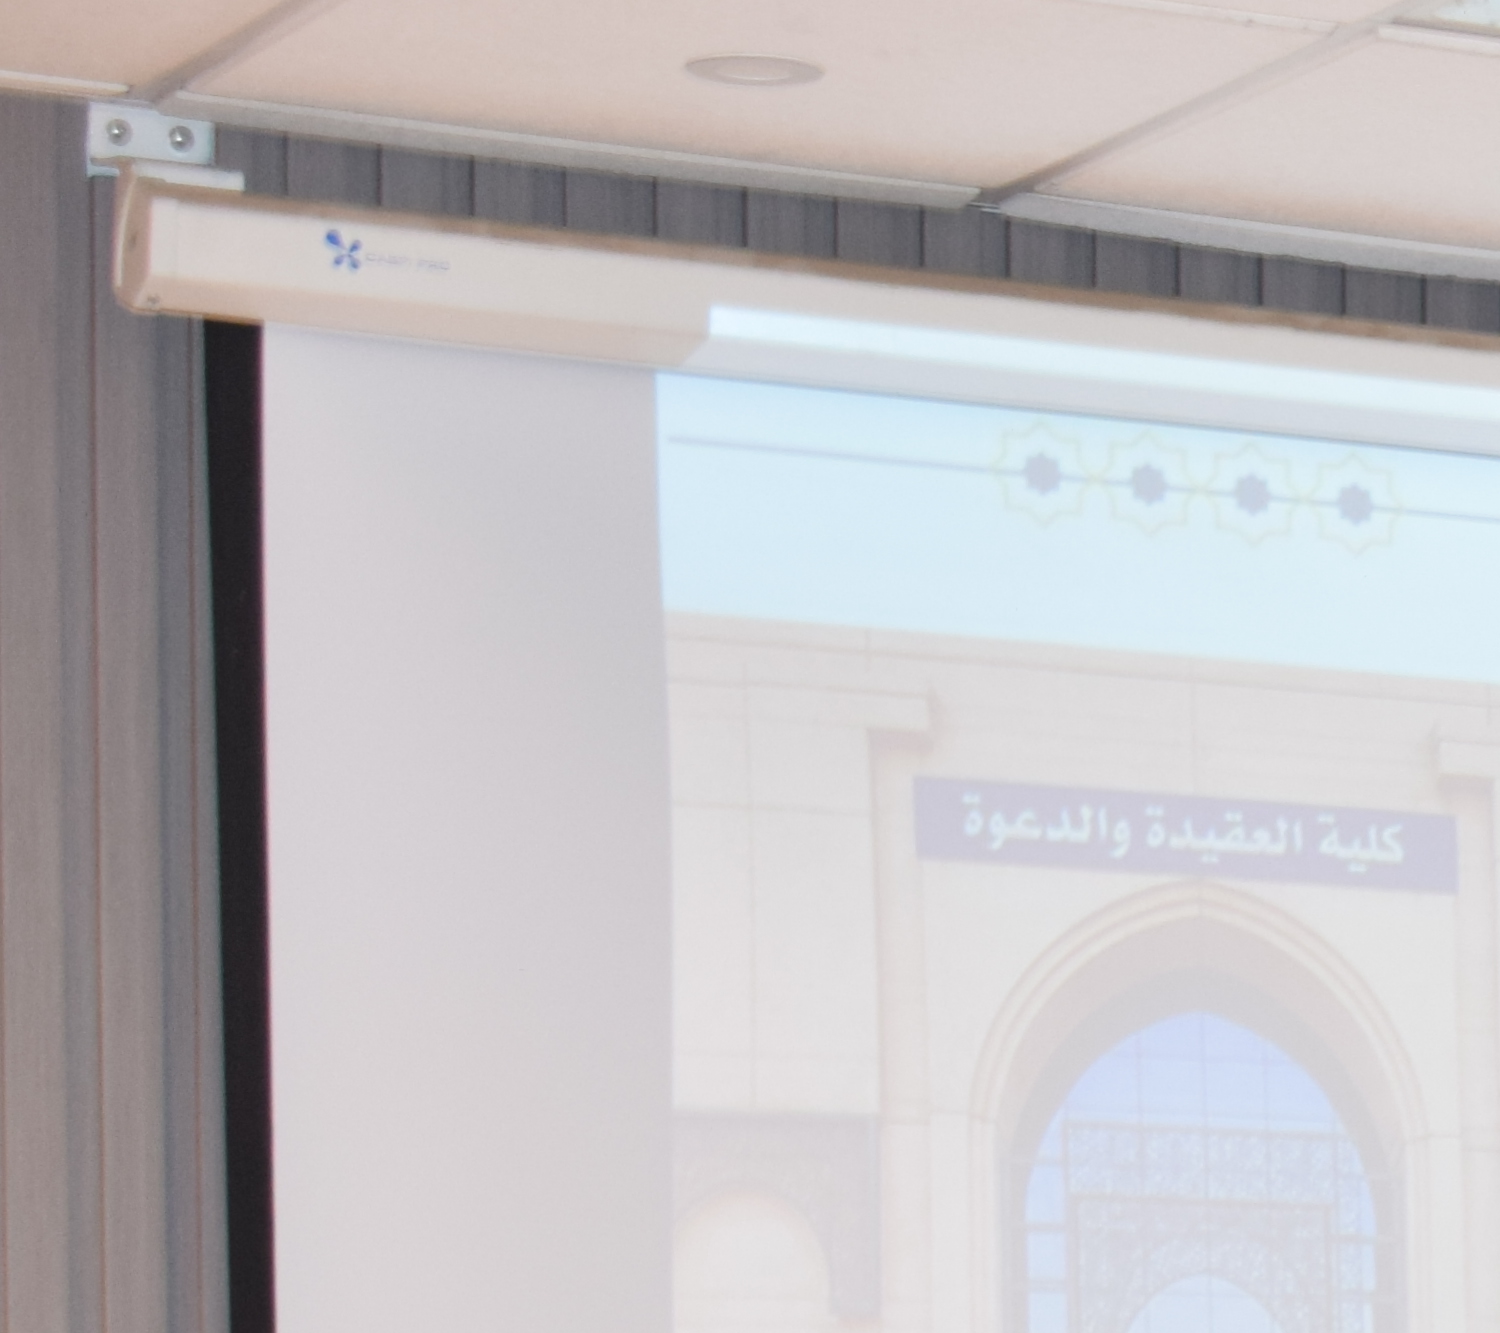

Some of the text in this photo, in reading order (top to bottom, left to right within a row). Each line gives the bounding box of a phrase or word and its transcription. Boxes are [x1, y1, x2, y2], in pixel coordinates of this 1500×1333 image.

[962, 793, 1405, 872] كلية العقيدة والدعوة
